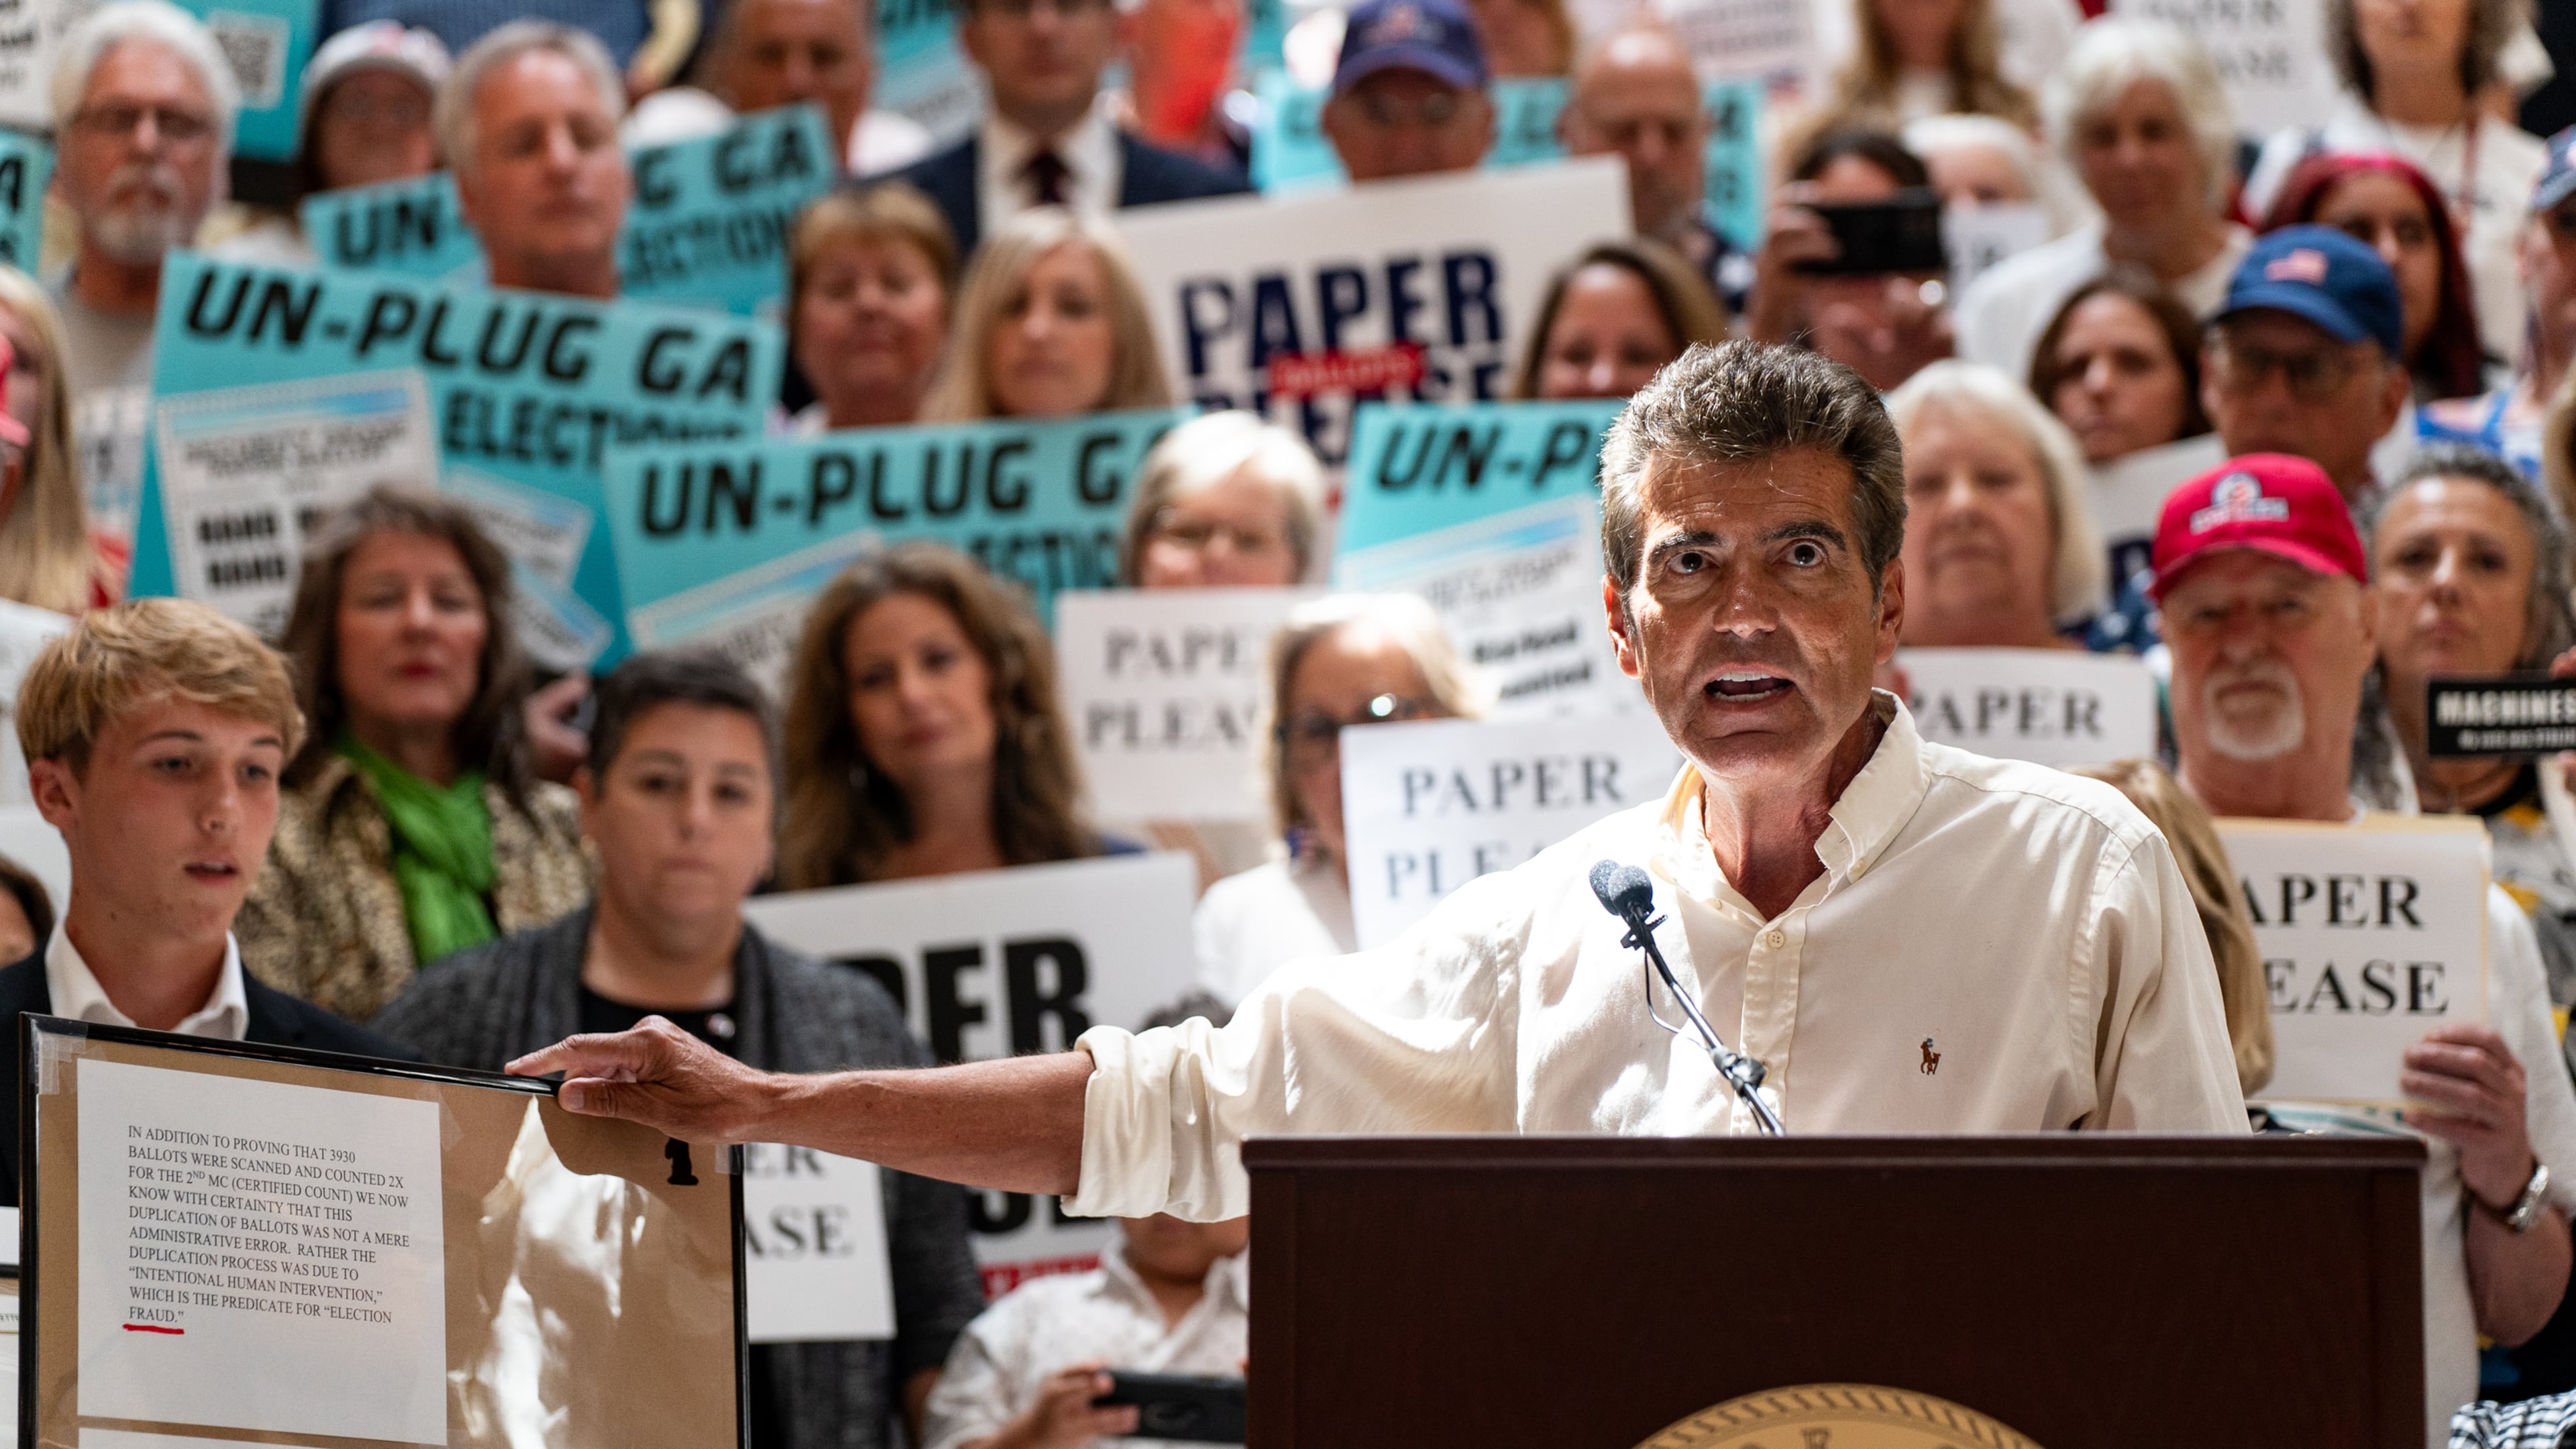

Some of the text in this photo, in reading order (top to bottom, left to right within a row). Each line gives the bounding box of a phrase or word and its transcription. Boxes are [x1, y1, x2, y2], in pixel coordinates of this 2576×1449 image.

[1179, 247, 1503, 375] PAPER
[184, 268, 753, 402] UN-PLUG GA
[1373, 421, 1600, 492] UN-P
[641, 438, 1030, 537] UN-PLUG
[2436, 688, 2576, 727] MACHINES
[1403, 754, 1626, 818] PAPER
[1386, 840, 1547, 899] PLE
[128, 1125, 356, 1164] IN ADDITION TO PROVING THAT 3930
[128, 1145, 404, 1189] BALLOTS WERE SCANNED AND COUNTED 2X
[128, 1165, 155, 1180] FOR
[157, 1168, 184, 1183] THE
[208, 1174, 229, 1189] MC
[231, 1177, 302, 1196] (CERTIFIED
[305, 1185, 353, 1205] COUNT)
[355, 1191, 376, 1205] WE
[378, 1193, 409, 1208] NOW
[129, 1185, 353, 1222] KNOW WITH CERTAINTY THAT THIS
[129, 1205, 410, 1248] DUPLICATION OF BALLOTS WAS NOT A MERE
[129, 1226, 376, 1264] ADMINISTRATIVE ERROR. RATHER THE
[129, 1245, 359, 1281] DUPLICATION PROCESS WAS DUE TO
[227, 1275, 276, 1292] HUMAN
[129, 1285, 174, 1303] WHICH
[178, 1291, 190, 1304] IS
[192, 1292, 219, 1307] THE
[221, 1295, 293, 1314] PREDICATE
[296, 1302, 321, 1317] FOR
